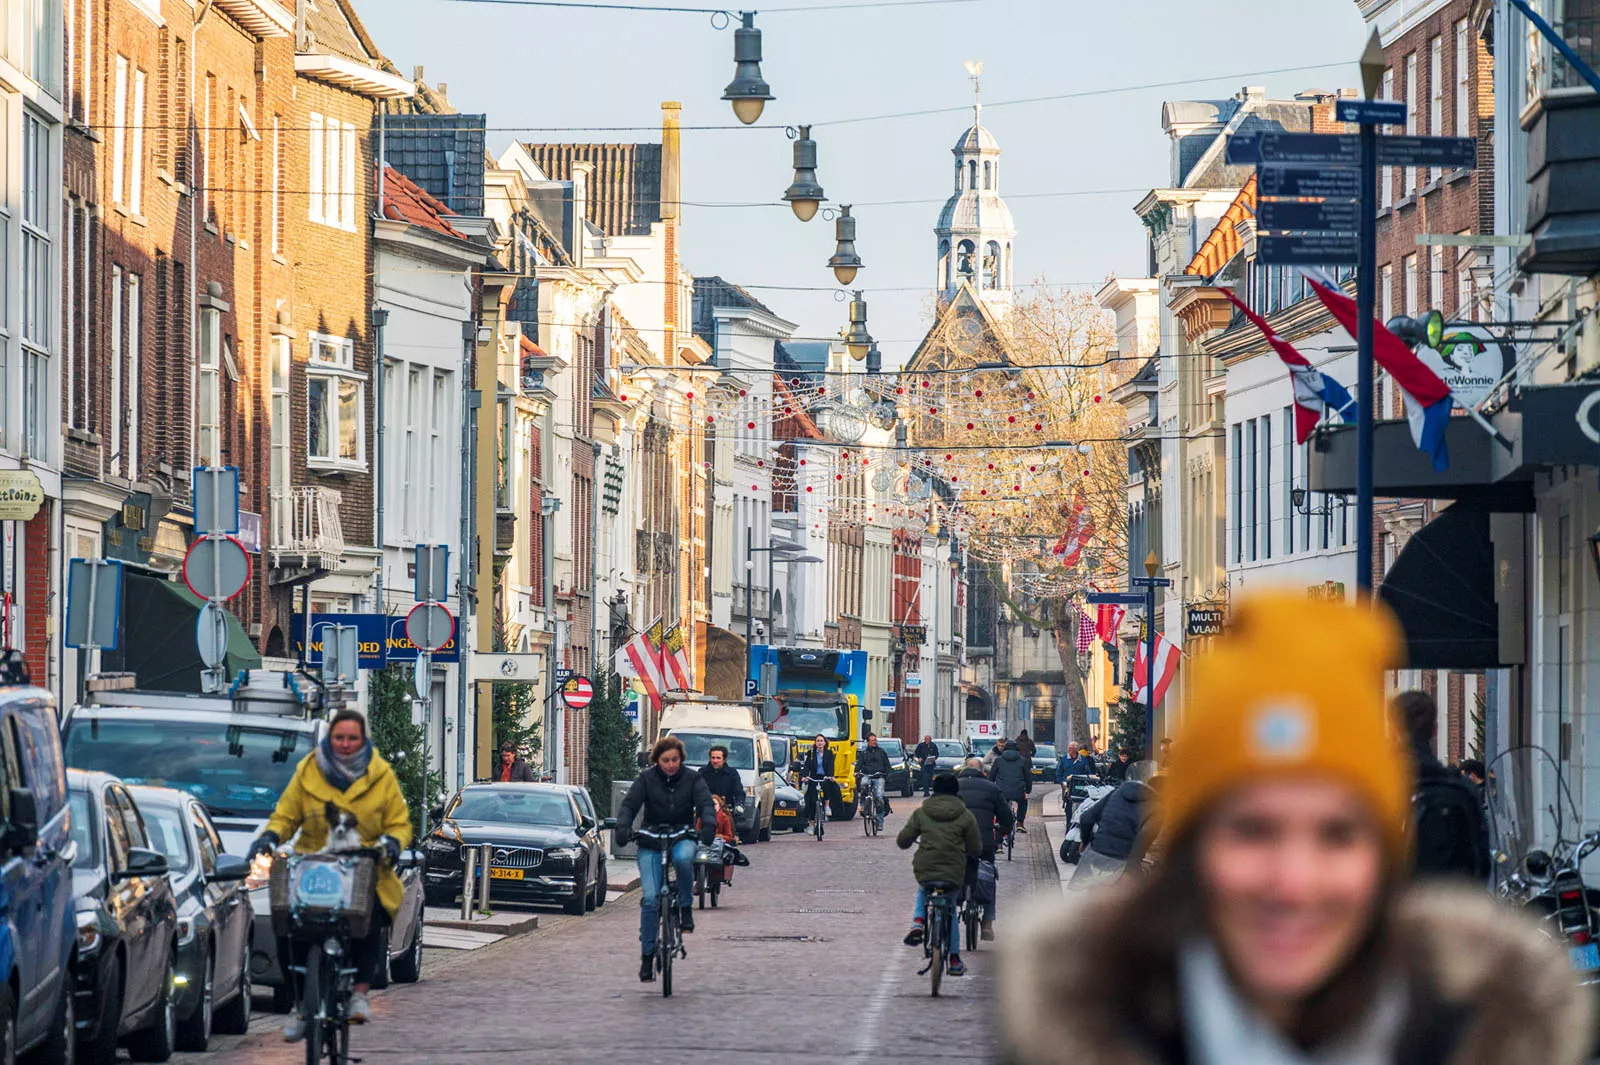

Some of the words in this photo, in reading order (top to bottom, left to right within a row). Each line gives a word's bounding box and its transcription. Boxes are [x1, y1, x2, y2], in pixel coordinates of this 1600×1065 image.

[0, 488, 38, 502] tPoint
[1191, 612, 1221, 622] MULTI
[1192, 625, 1220, 634] VLAAI
[746, 680, 756, 695] P
[490, 869, 520, 878] N-314-X
